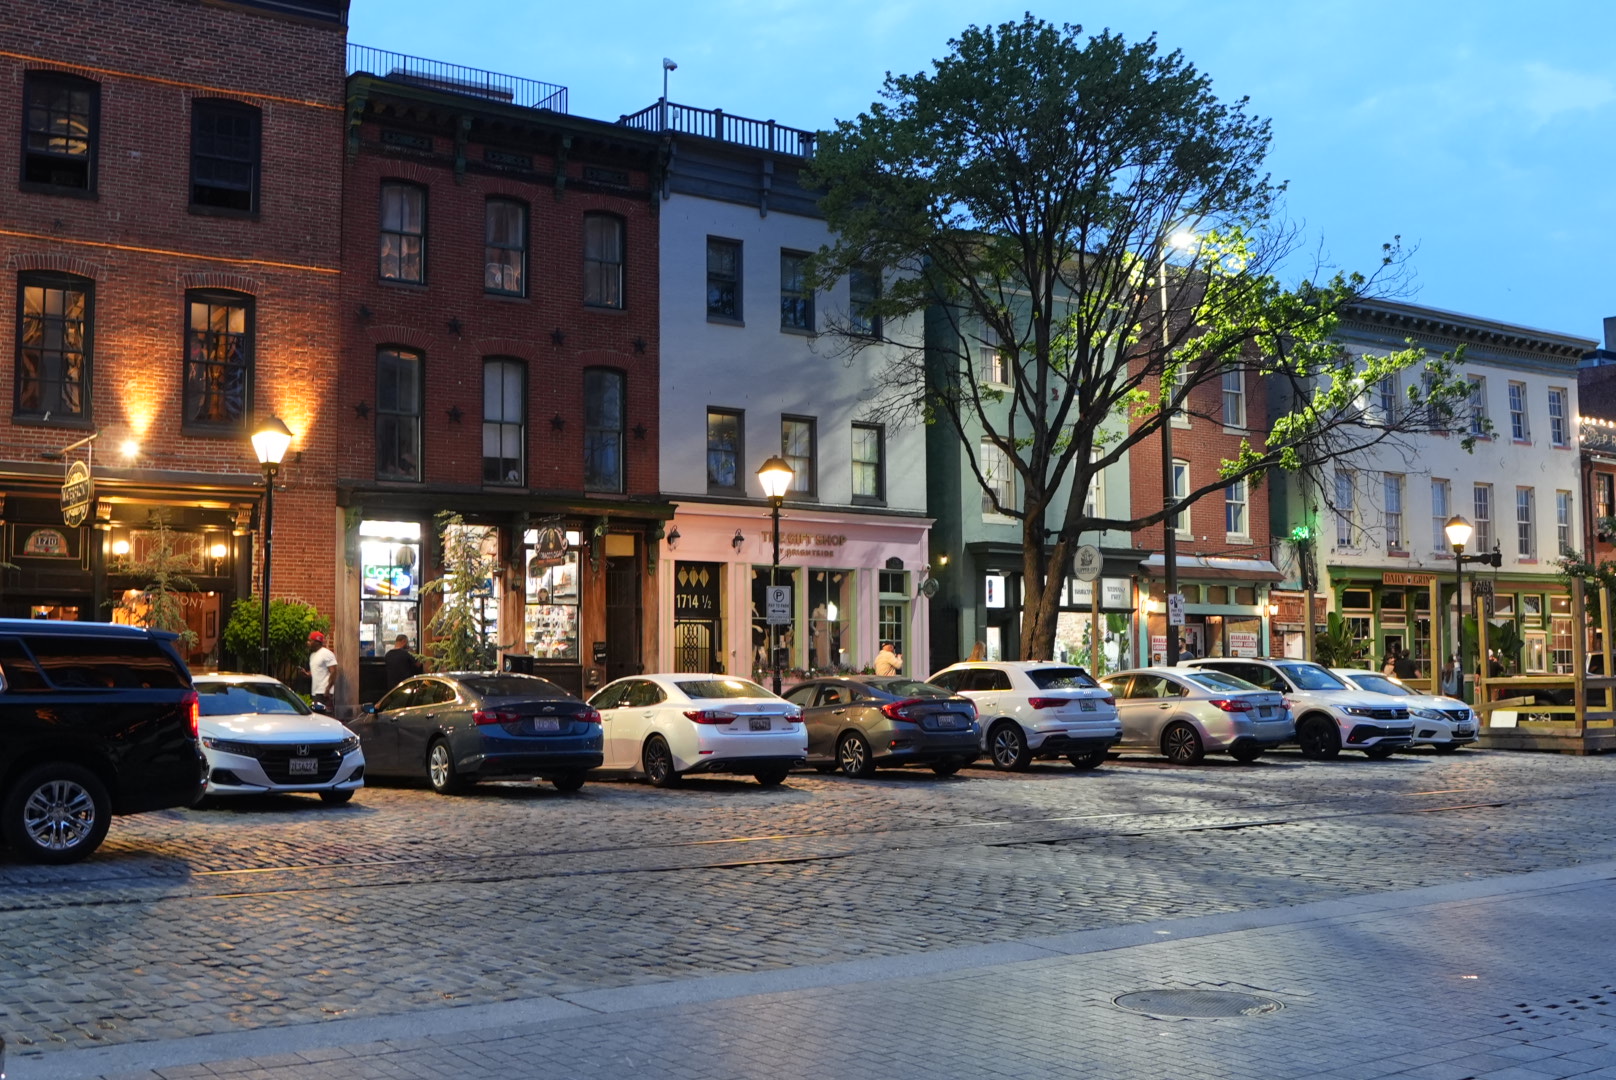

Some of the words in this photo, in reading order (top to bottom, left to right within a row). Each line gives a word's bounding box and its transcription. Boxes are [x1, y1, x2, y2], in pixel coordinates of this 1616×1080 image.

[786, 533, 813, 546] GIFT
[815, 534, 847, 547] SHOP
[786, 549, 834, 557] BRIGHTSIDE
[365, 565, 404, 581] Cigars
[1384, 573, 1405, 582] DAILY
[676, 594, 699, 608] 1714
